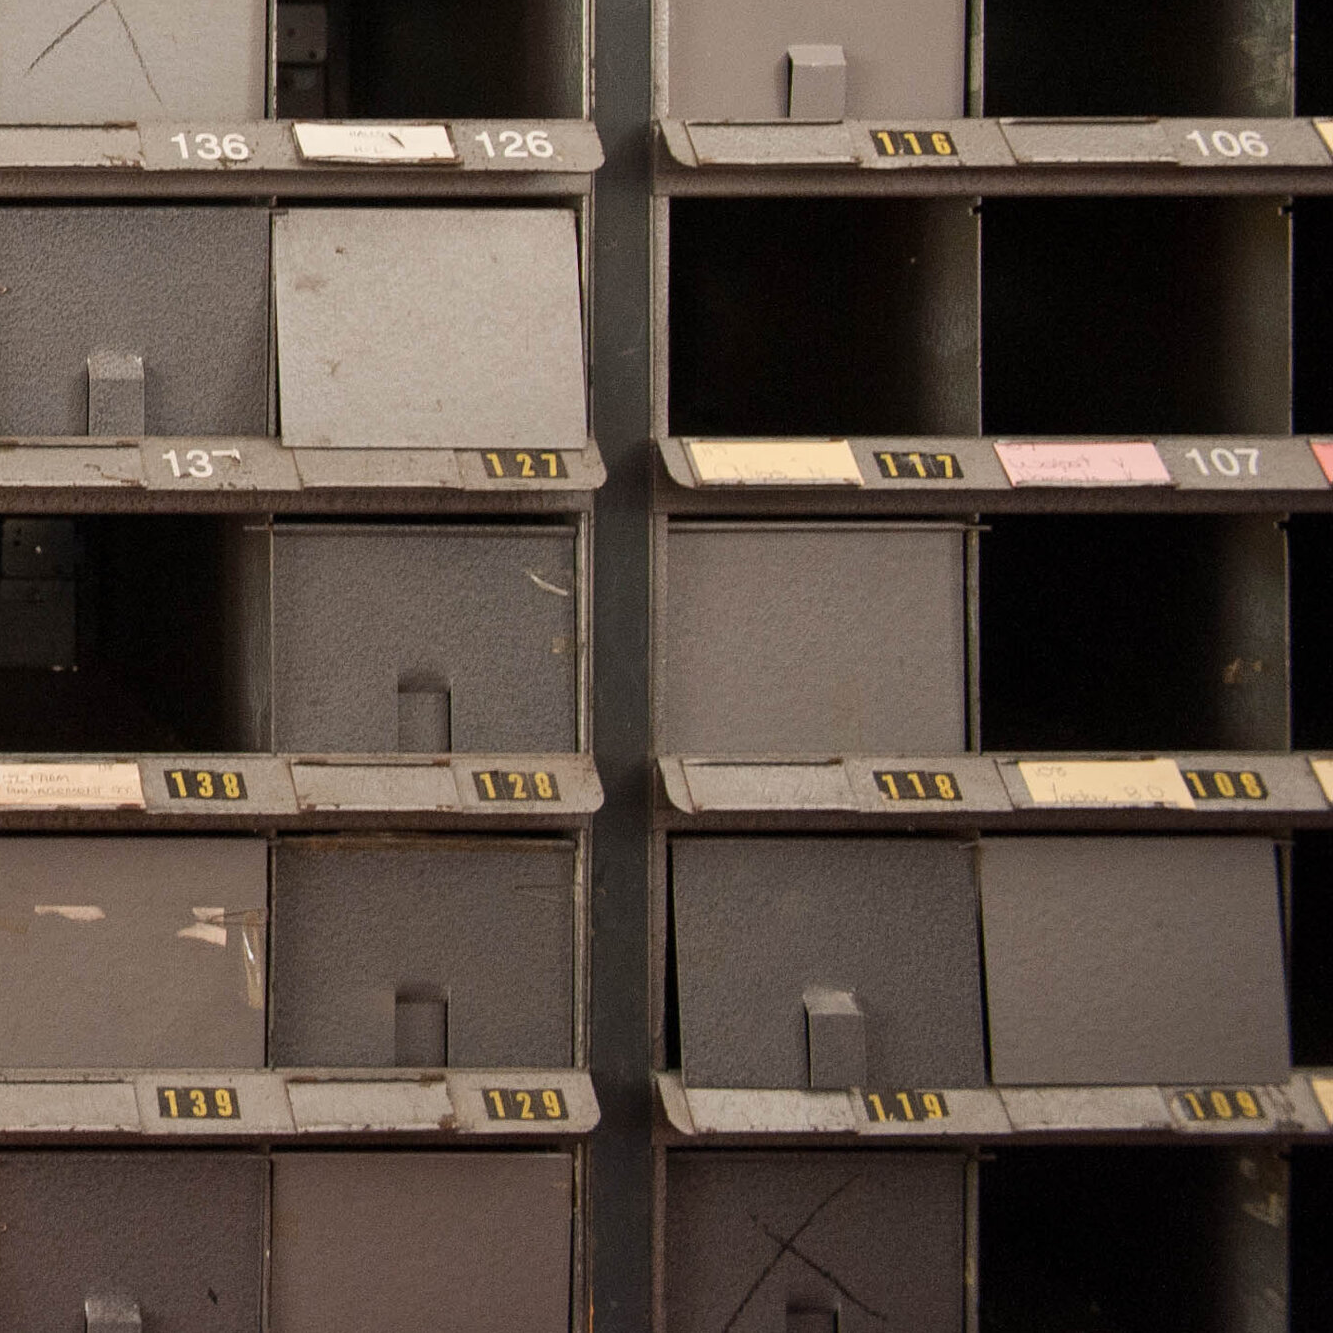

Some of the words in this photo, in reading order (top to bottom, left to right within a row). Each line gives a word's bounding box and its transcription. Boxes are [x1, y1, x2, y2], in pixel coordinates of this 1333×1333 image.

[170, 131, 250, 162] 136
[474, 130, 555, 160] 126
[877, 131, 951, 155] 116
[1185, 128, 1270, 158] 106
[487, 453, 557, 478] 127
[881, 453, 953, 479] 117
[1183, 447, 1261, 478] 107
[171, 771, 240, 798] 138
[480, 771, 553, 799] 128
[882, 773, 955, 802] 118
[1187, 771, 1262, 798] 108
[164, 1088, 233, 1118] 139
[489, 1090, 561, 1120] 129
[869, 1093, 943, 1121] 119
[1185, 1091, 1258, 1118] 109
